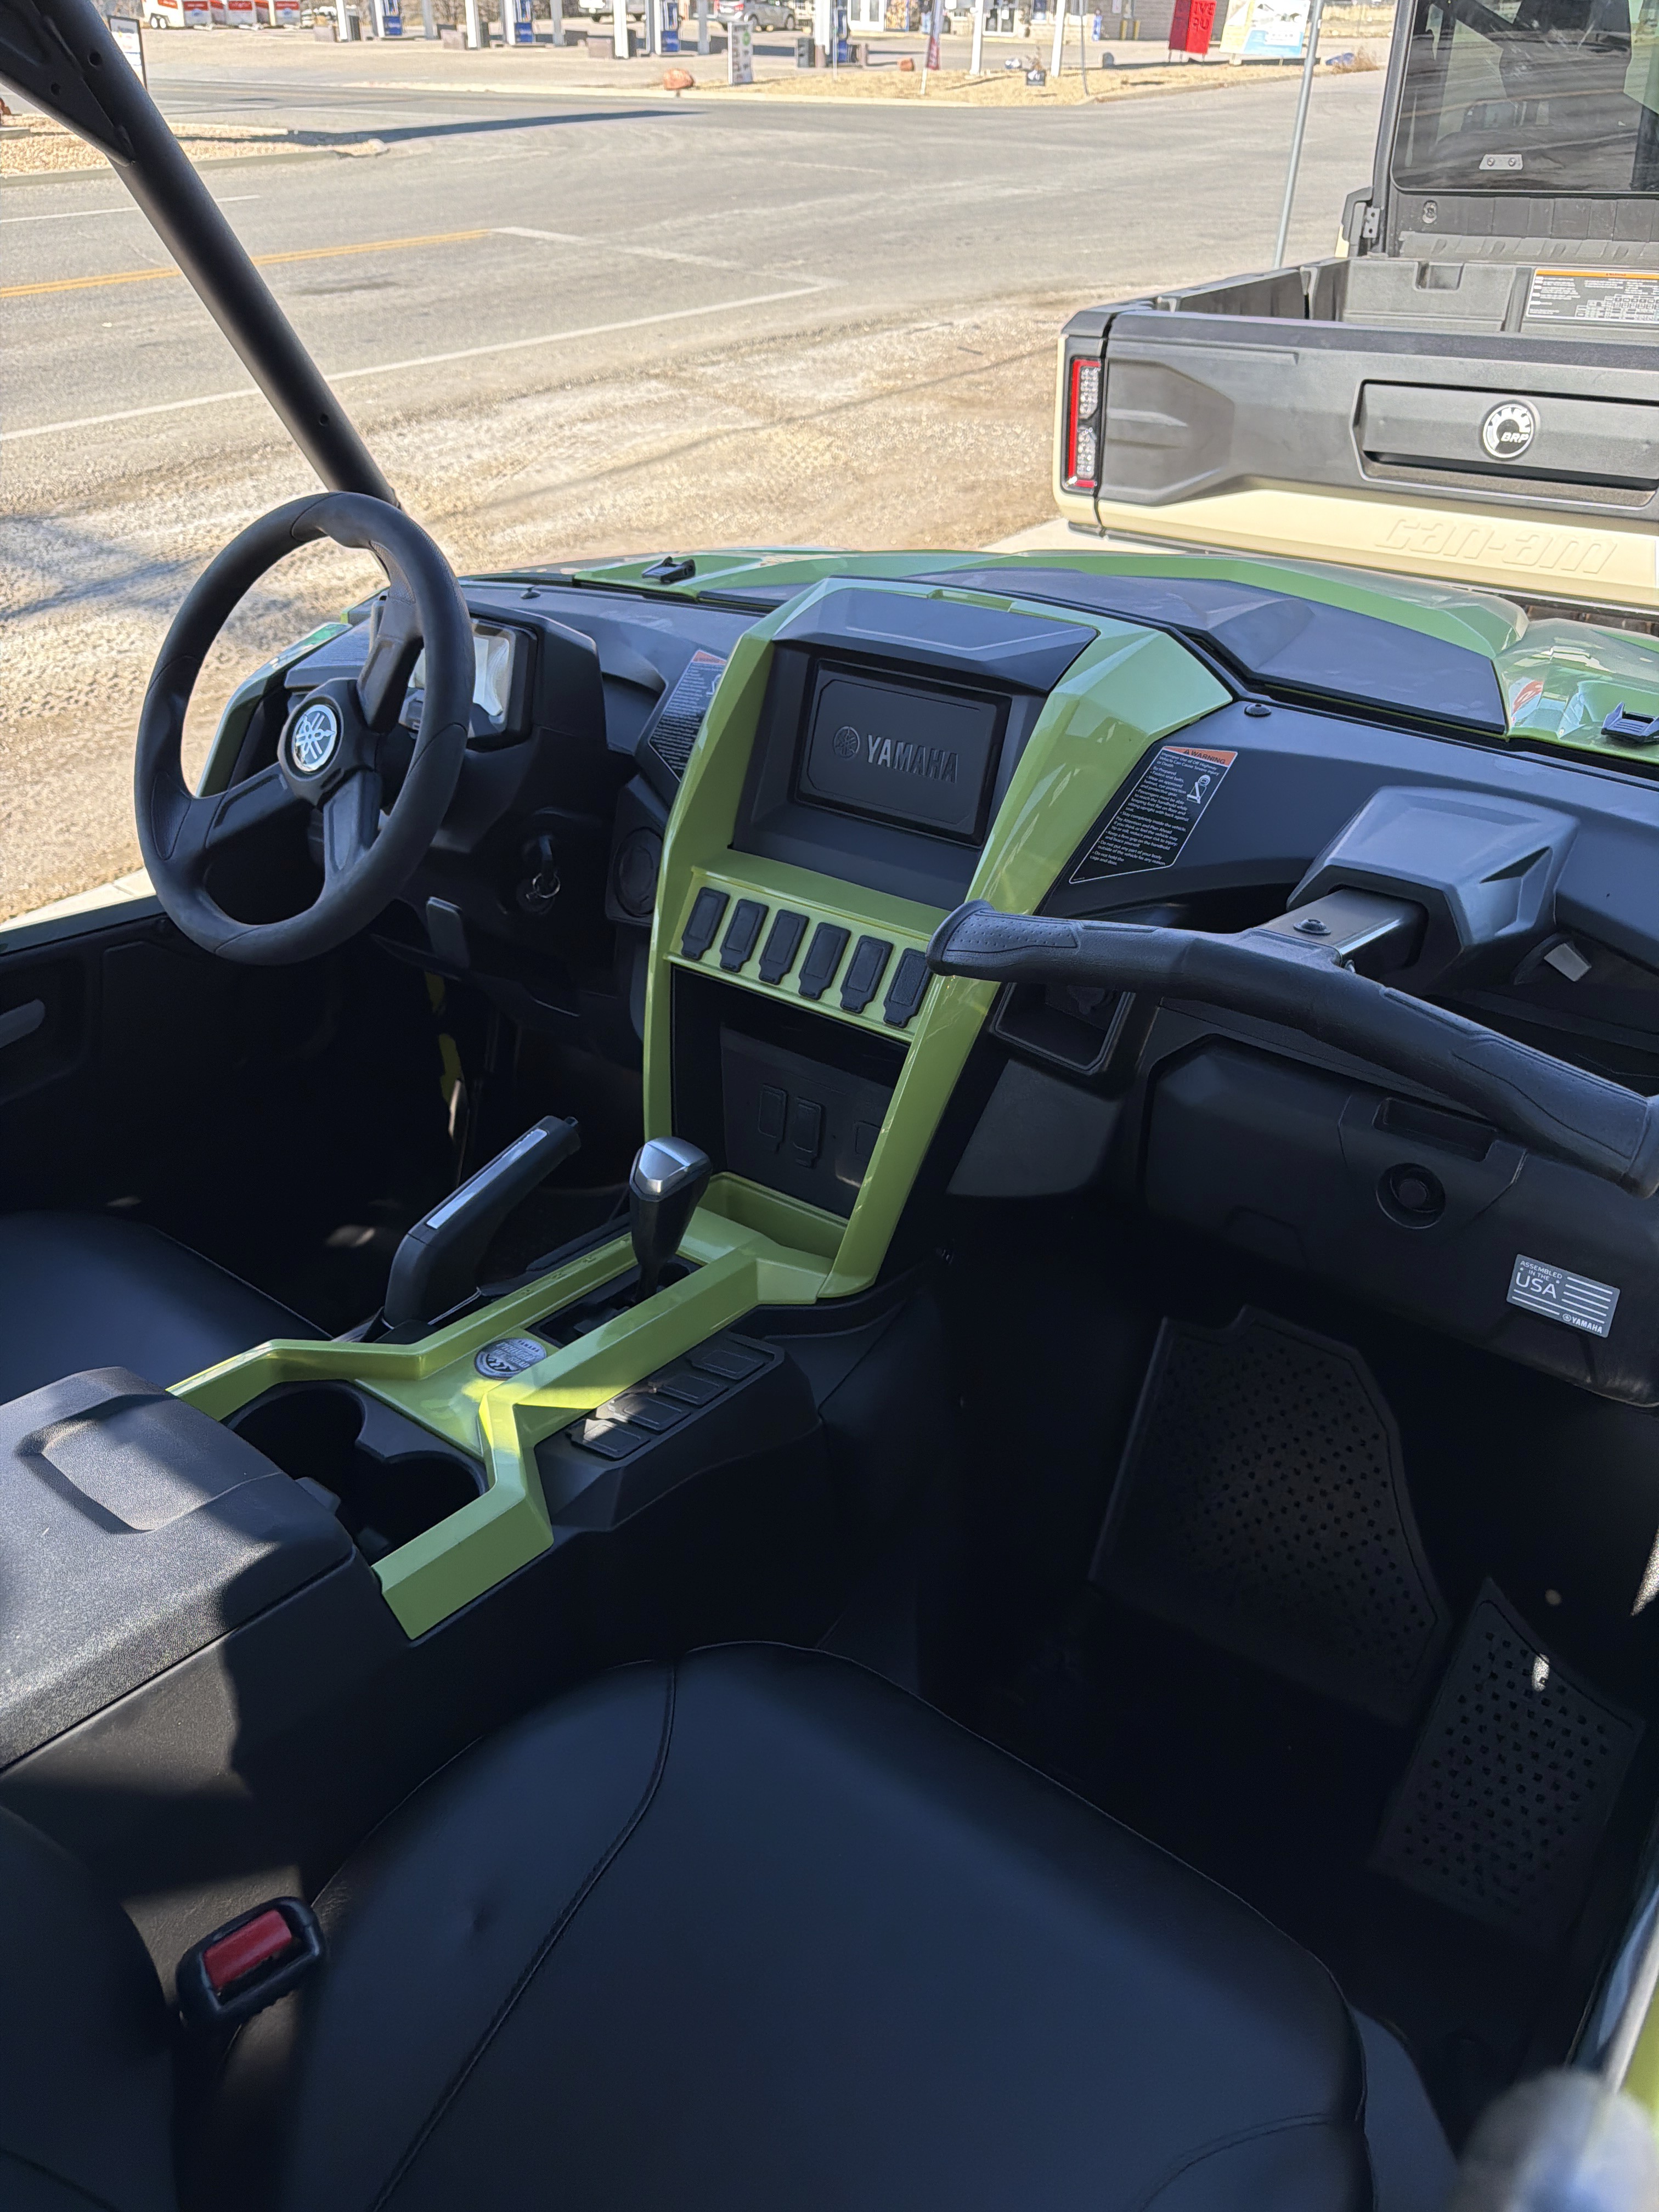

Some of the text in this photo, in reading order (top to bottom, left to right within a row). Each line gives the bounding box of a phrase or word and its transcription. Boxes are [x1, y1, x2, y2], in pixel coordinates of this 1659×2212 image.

[1500, 431, 1529, 443] BRP
[1374, 518, 1618, 574] can-am
[867, 734, 959, 783] YAMAHA
[1191, 750, 1226, 764] WARNING
[1138, 789, 1159, 798] Passengers
[1131, 797, 1147, 805] keeping
[1157, 799, 1176, 808] handhold
[1131, 814, 1152, 822] completely
[1520, 1260, 1562, 1279] ASSEMBLED
[1537, 1272, 1550, 1281] THE
[1516, 1272, 1556, 1299] USA
[1571, 1316, 1602, 1334] YAMAHA
[496, 1342, 536, 1362] PROVEN
[517, 1340, 540, 1352] YAMAHA
